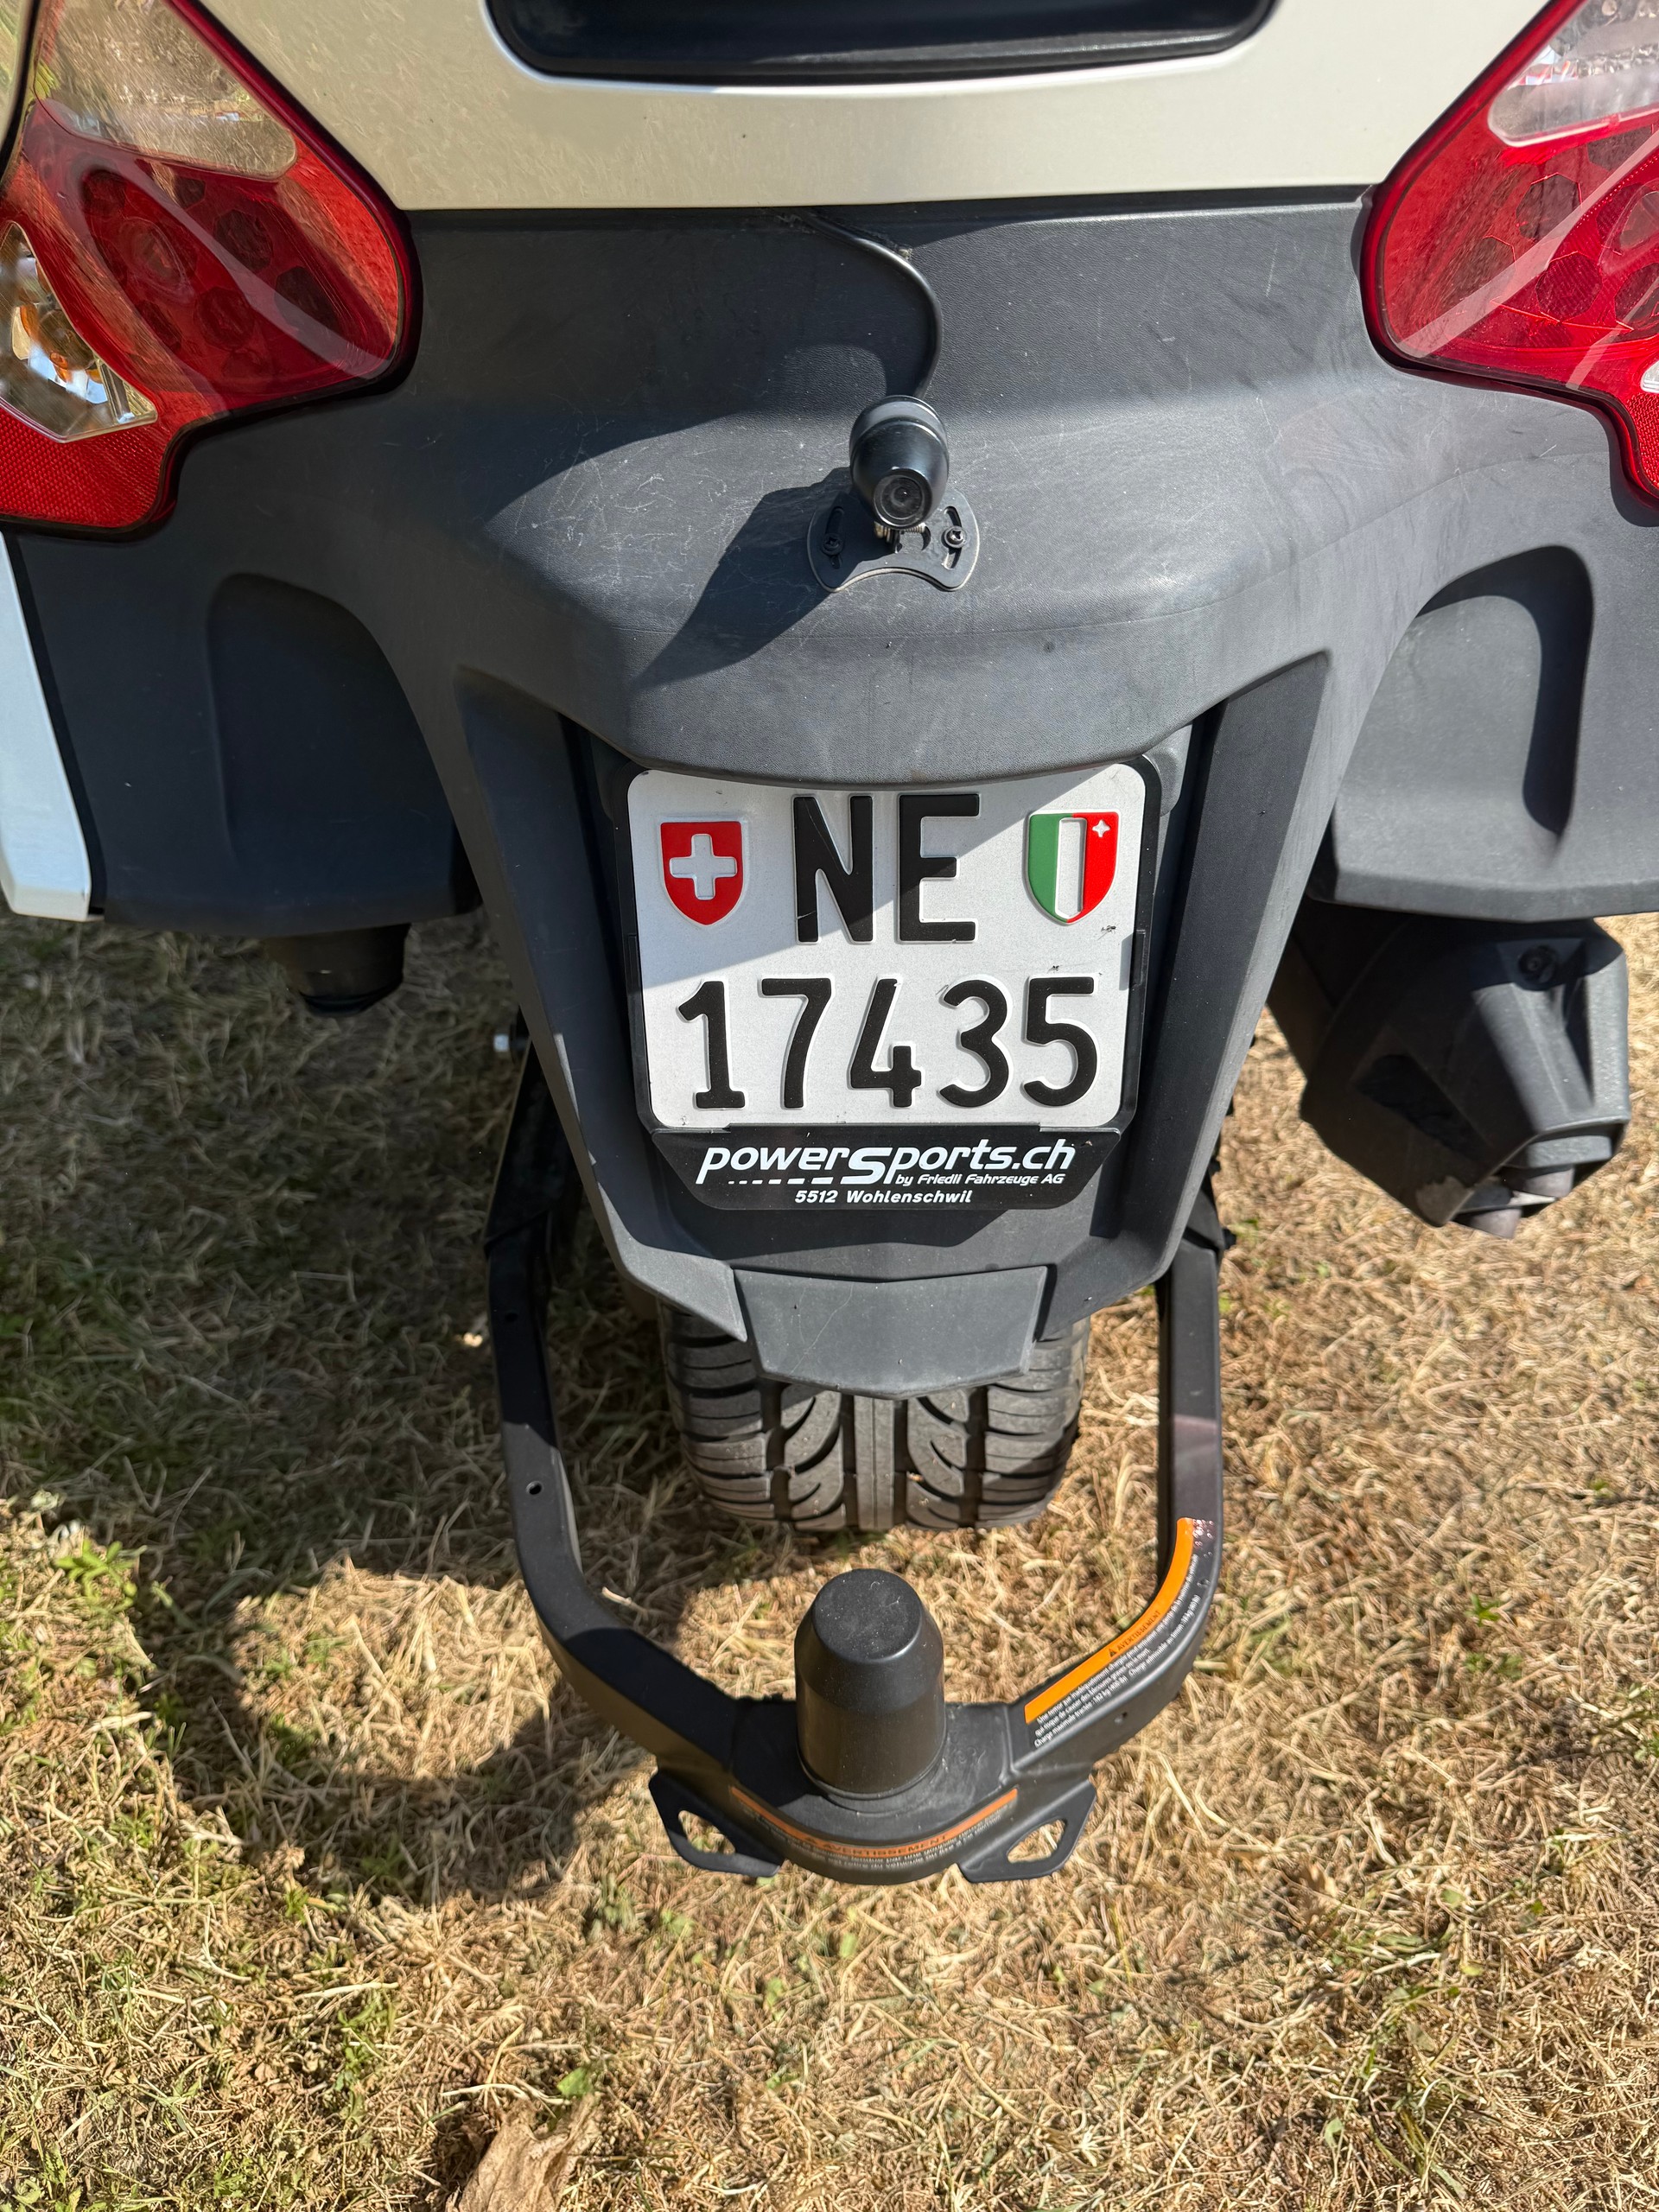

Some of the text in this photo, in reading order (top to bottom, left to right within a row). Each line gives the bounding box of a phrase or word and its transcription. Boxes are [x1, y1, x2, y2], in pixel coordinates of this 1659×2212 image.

[793, 793, 979, 942] NE
[679, 977, 1096, 1109] 17435
[696, 1138, 1077, 1185] powerSports.ch
[895, 1173, 1064, 1186] by Friedli Fahrzeuge AG
[795, 1189, 972, 1203] 5512 Wohlenschwil
